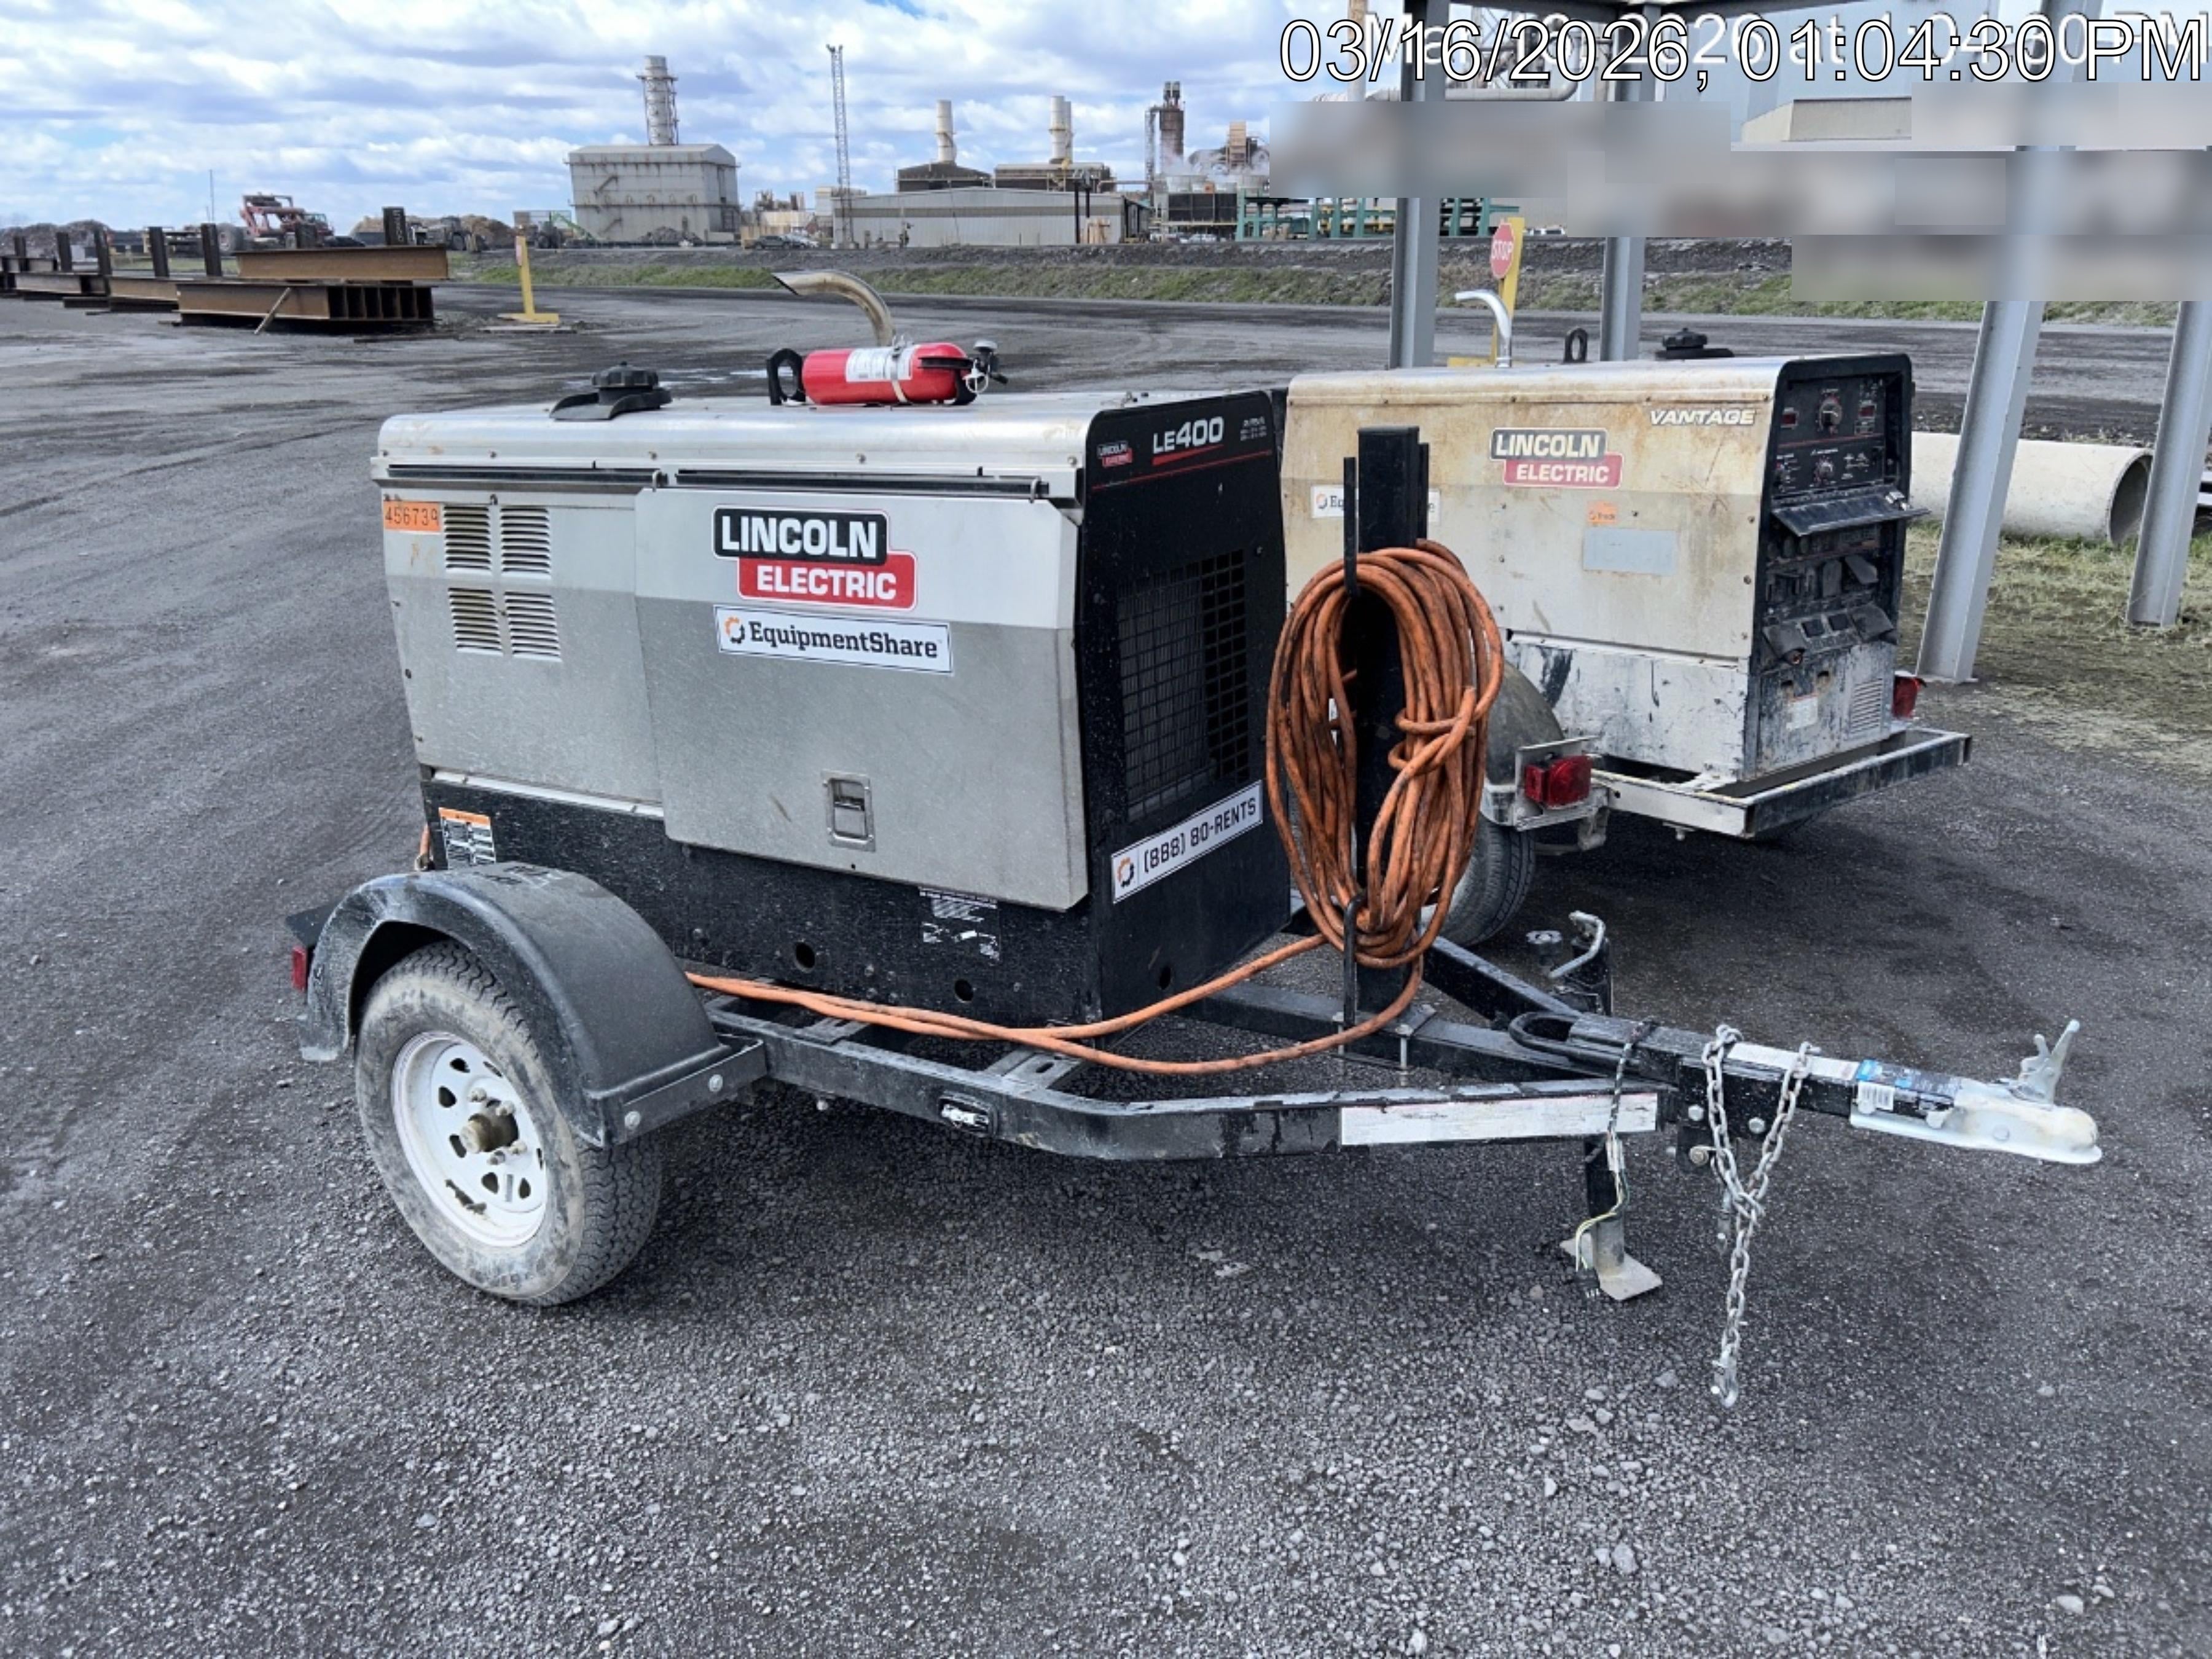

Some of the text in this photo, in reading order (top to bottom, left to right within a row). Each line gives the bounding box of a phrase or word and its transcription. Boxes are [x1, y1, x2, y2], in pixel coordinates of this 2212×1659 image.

[1491, 239, 1513, 261] STOP
[1650, 409, 1756, 426] VANTAGE
[1152, 416, 1225, 455] LE400
[1495, 434, 1601, 458] LINCOLN
[1515, 463, 1610, 484] ELECTRIC
[385, 506, 439, 526] 456739
[721, 515, 877, 559] LINCOLN
[756, 565, 897, 600] ELECTRIC
[748, 620, 938, 659] EquipmentShare
[1143, 797, 1257, 873] (888) 80-RENTS
